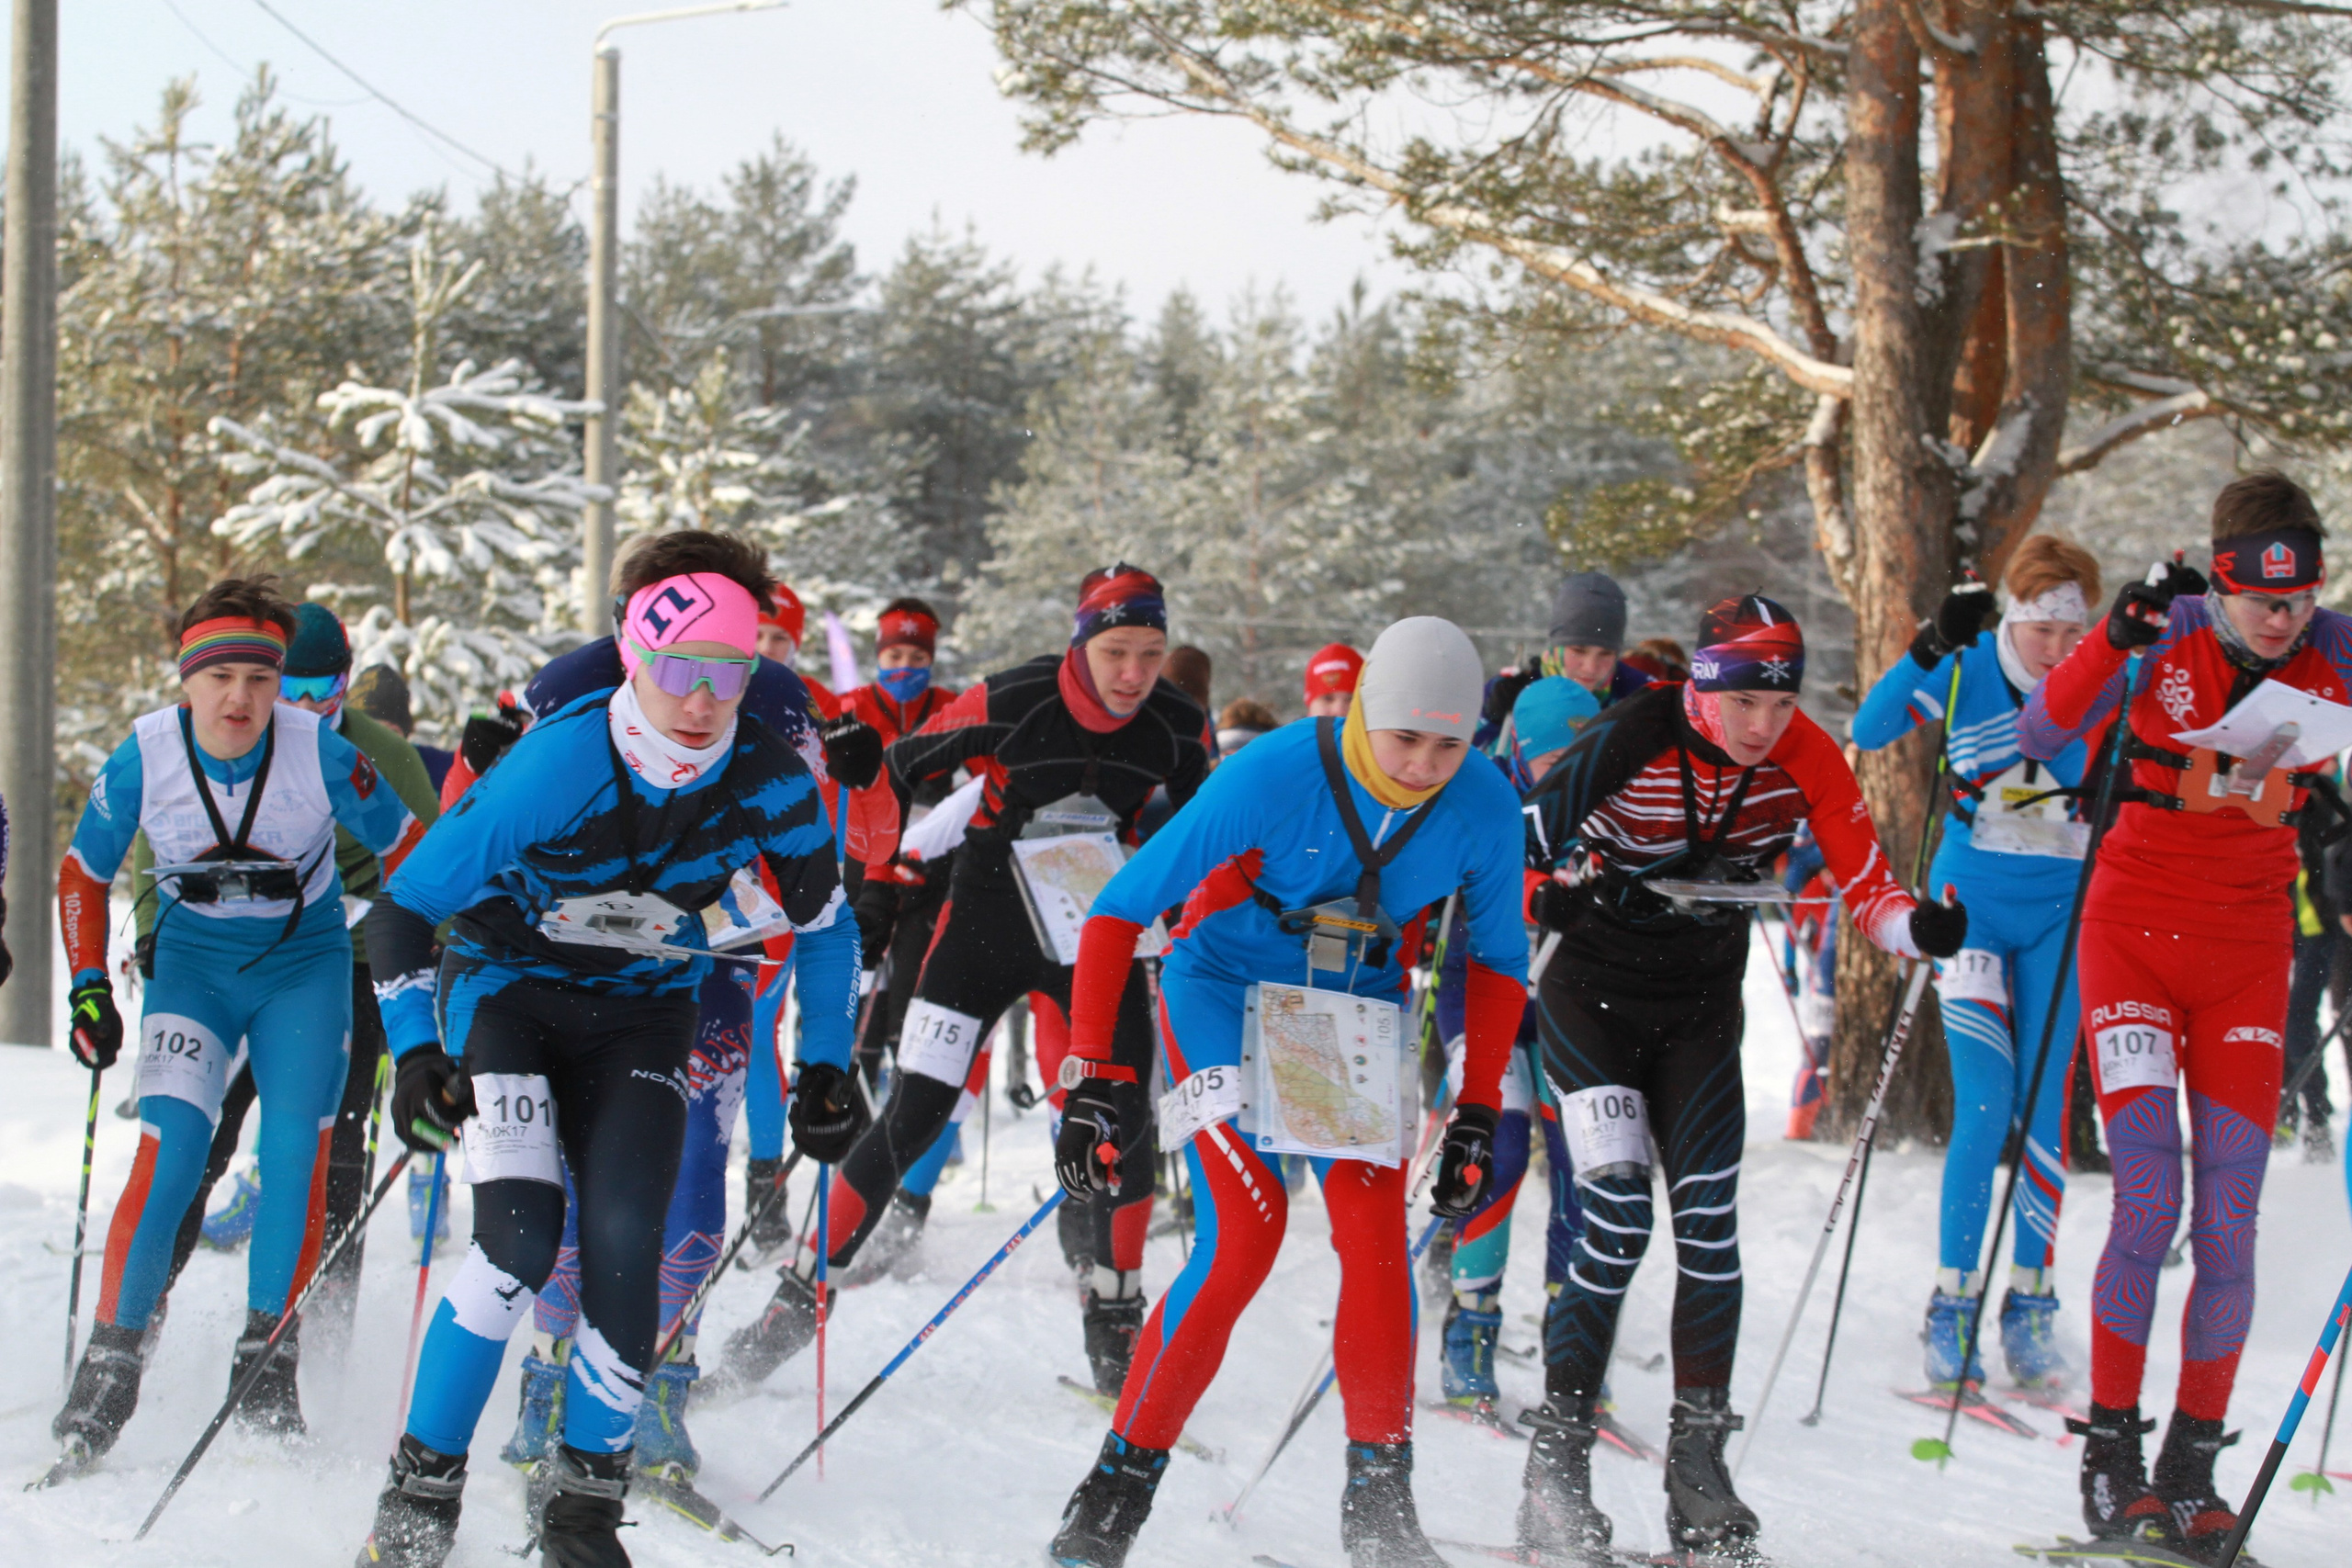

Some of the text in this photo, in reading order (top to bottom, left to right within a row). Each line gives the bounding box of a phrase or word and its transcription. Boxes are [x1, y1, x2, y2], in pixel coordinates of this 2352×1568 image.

[64, 891, 83, 967] 102sport.ru
[2090, 1000, 2173, 1027] RUSSIA
[920, 1014, 961, 1044] 115
[2108, 1031, 2157, 1056] 107
[154, 1029, 202, 1061] 102
[207, 1061, 212, 1074] 1
[1178, 1067, 1224, 1105] 105
[493, 1095, 550, 1127] 101
[1587, 1094, 1636, 1122] 106
